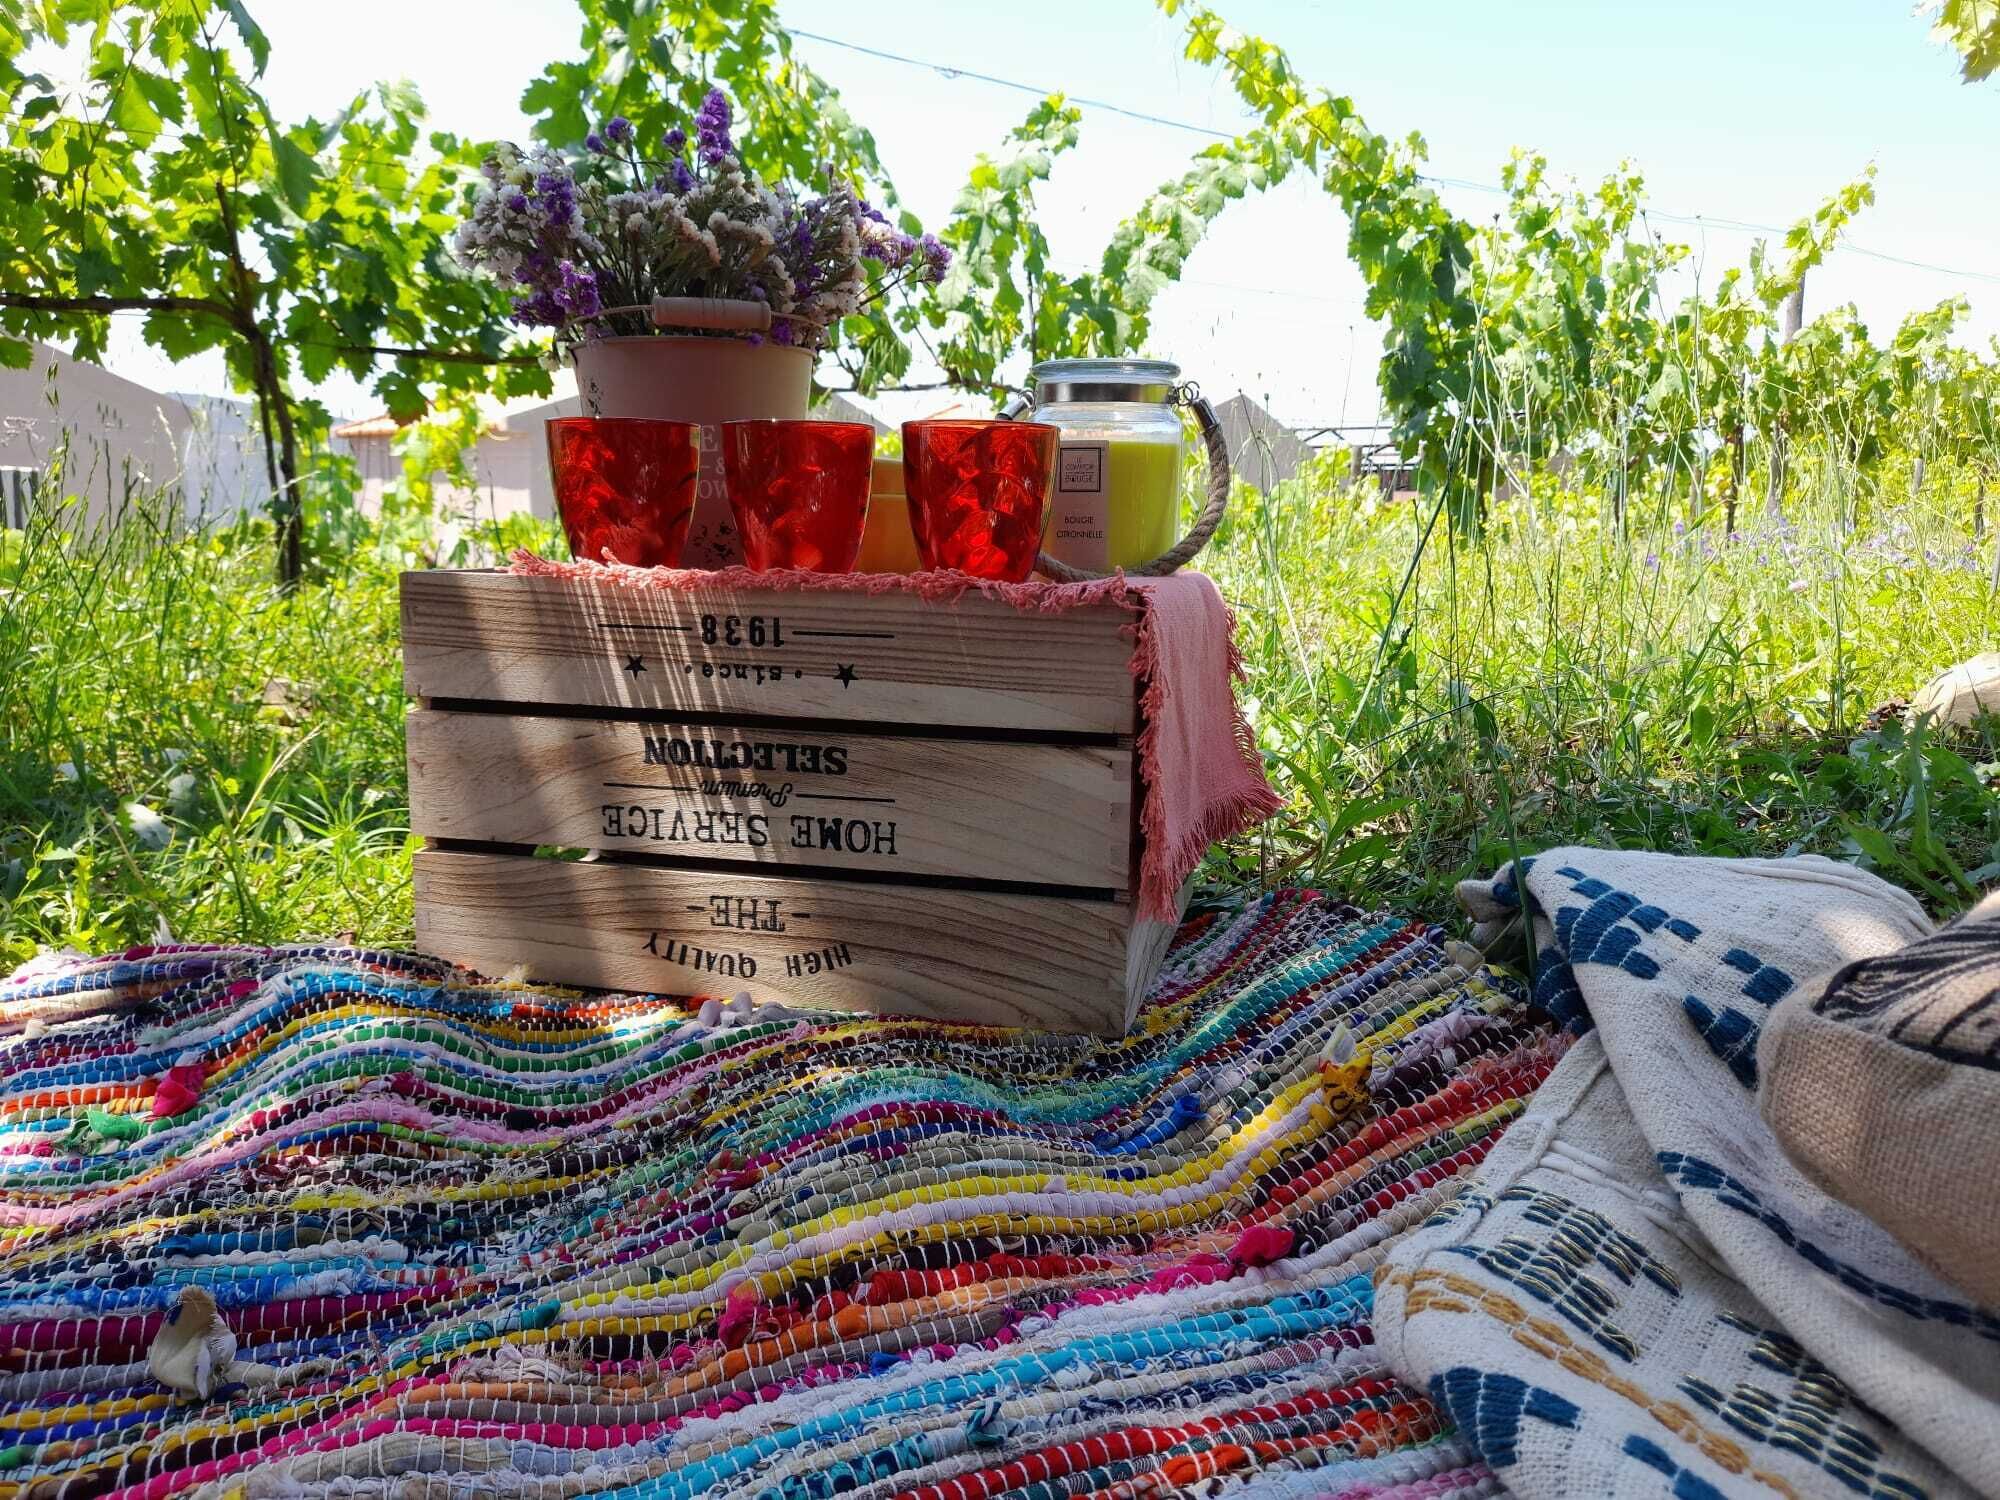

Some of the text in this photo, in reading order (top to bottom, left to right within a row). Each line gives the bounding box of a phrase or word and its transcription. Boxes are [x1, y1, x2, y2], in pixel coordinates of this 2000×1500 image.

[1056, 529, 1104, 539] CITRONNELLE
[1064, 515, 1095, 525] BOUGIE
[701, 614, 785, 647] 1938
[702, 663, 782, 686] since
[643, 736, 848, 775] SELECTION
[700, 778, 793, 808] Premium
[602, 805, 898, 855] HOME SERVICE
[709, 895, 786, 932] THE
[642, 932, 853, 978] HIGH QUALITY
